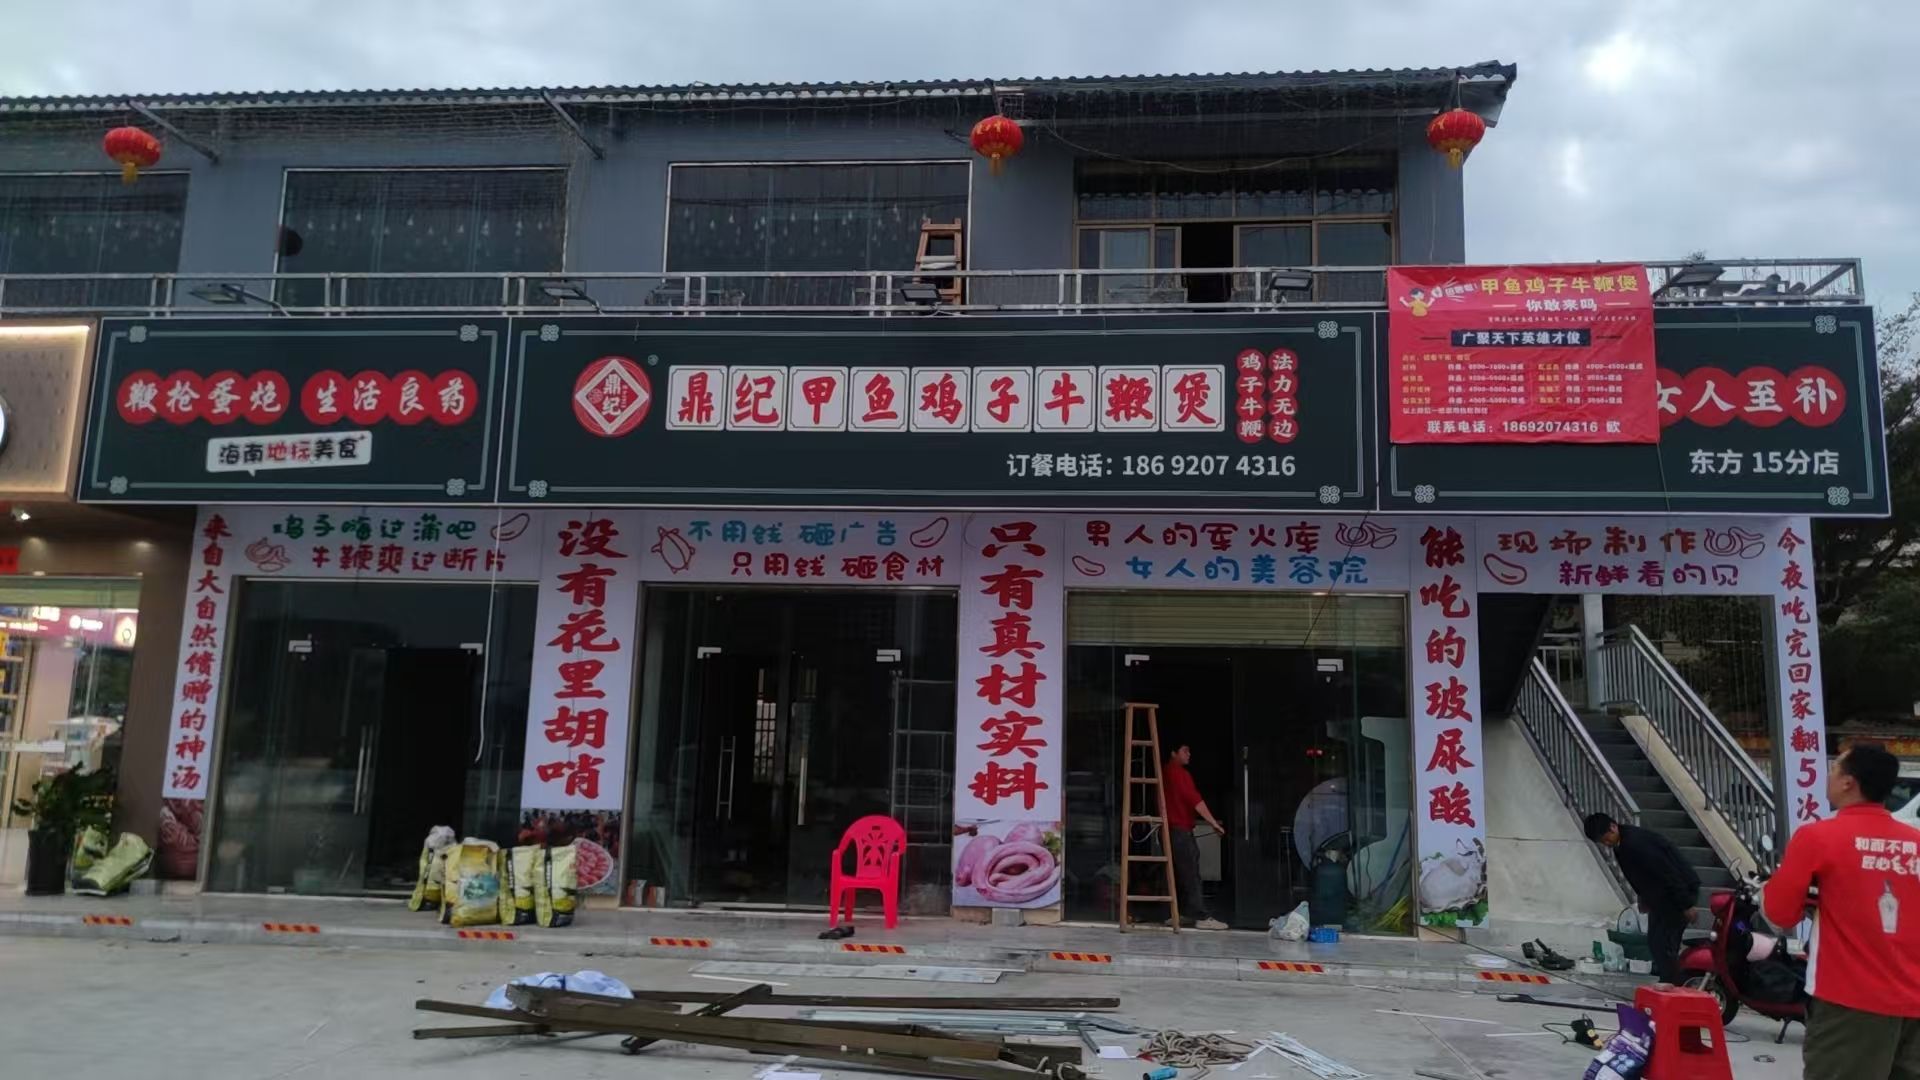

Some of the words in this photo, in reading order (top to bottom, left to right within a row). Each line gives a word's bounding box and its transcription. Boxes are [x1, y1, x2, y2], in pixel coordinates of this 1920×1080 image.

[1480, 275, 1639, 296] 甲鱼鸡子牛鞭煲
[1526, 298, 1598, 313] 你敢来吗
[1461, 331, 1581, 346] 广聚天下英雄才俊
[124, 376, 282, 415] 鞭枪蛋炮
[316, 376, 466, 415] 生活良药
[677, 368, 1217, 425] 鼎纪甲鱼鸡子牛鞭煲
[1240, 353, 1265, 438] 鸡子牛鞭
[1272, 353, 1297, 438] 法力无边
[1502, 420, 1598, 433] 18692074316
[218, 437, 359, 466] 海南地标美食
[1122, 455, 1164, 476] 186
[1171, 455, 1229, 476] 9207
[1236, 455, 1296, 476] 4316
[1689, 449, 1743, 475] 东方
[1752, 450, 1839, 475] 15分店
[688, 520, 783, 545] 不用钱
[1086, 519, 1321, 553] 男人的军火库
[1497, 526, 1697, 555] 现场制作
[312, 544, 504, 573] 牛鞭爽过断片
[731, 551, 825, 577] 只用钱
[841, 551, 945, 580] 砸食材
[1126, 553, 1368, 585] 女人的美容院
[1559, 560, 1739, 587] 新鲜看的见
[536, 519, 628, 799] 没有花里胡哨
[968, 520, 1048, 810] 只有真材实料
[1419, 525, 1475, 828] 能吃的玻尿酸
[1777, 527, 1822, 823] 今夜吃完回家翻5次
